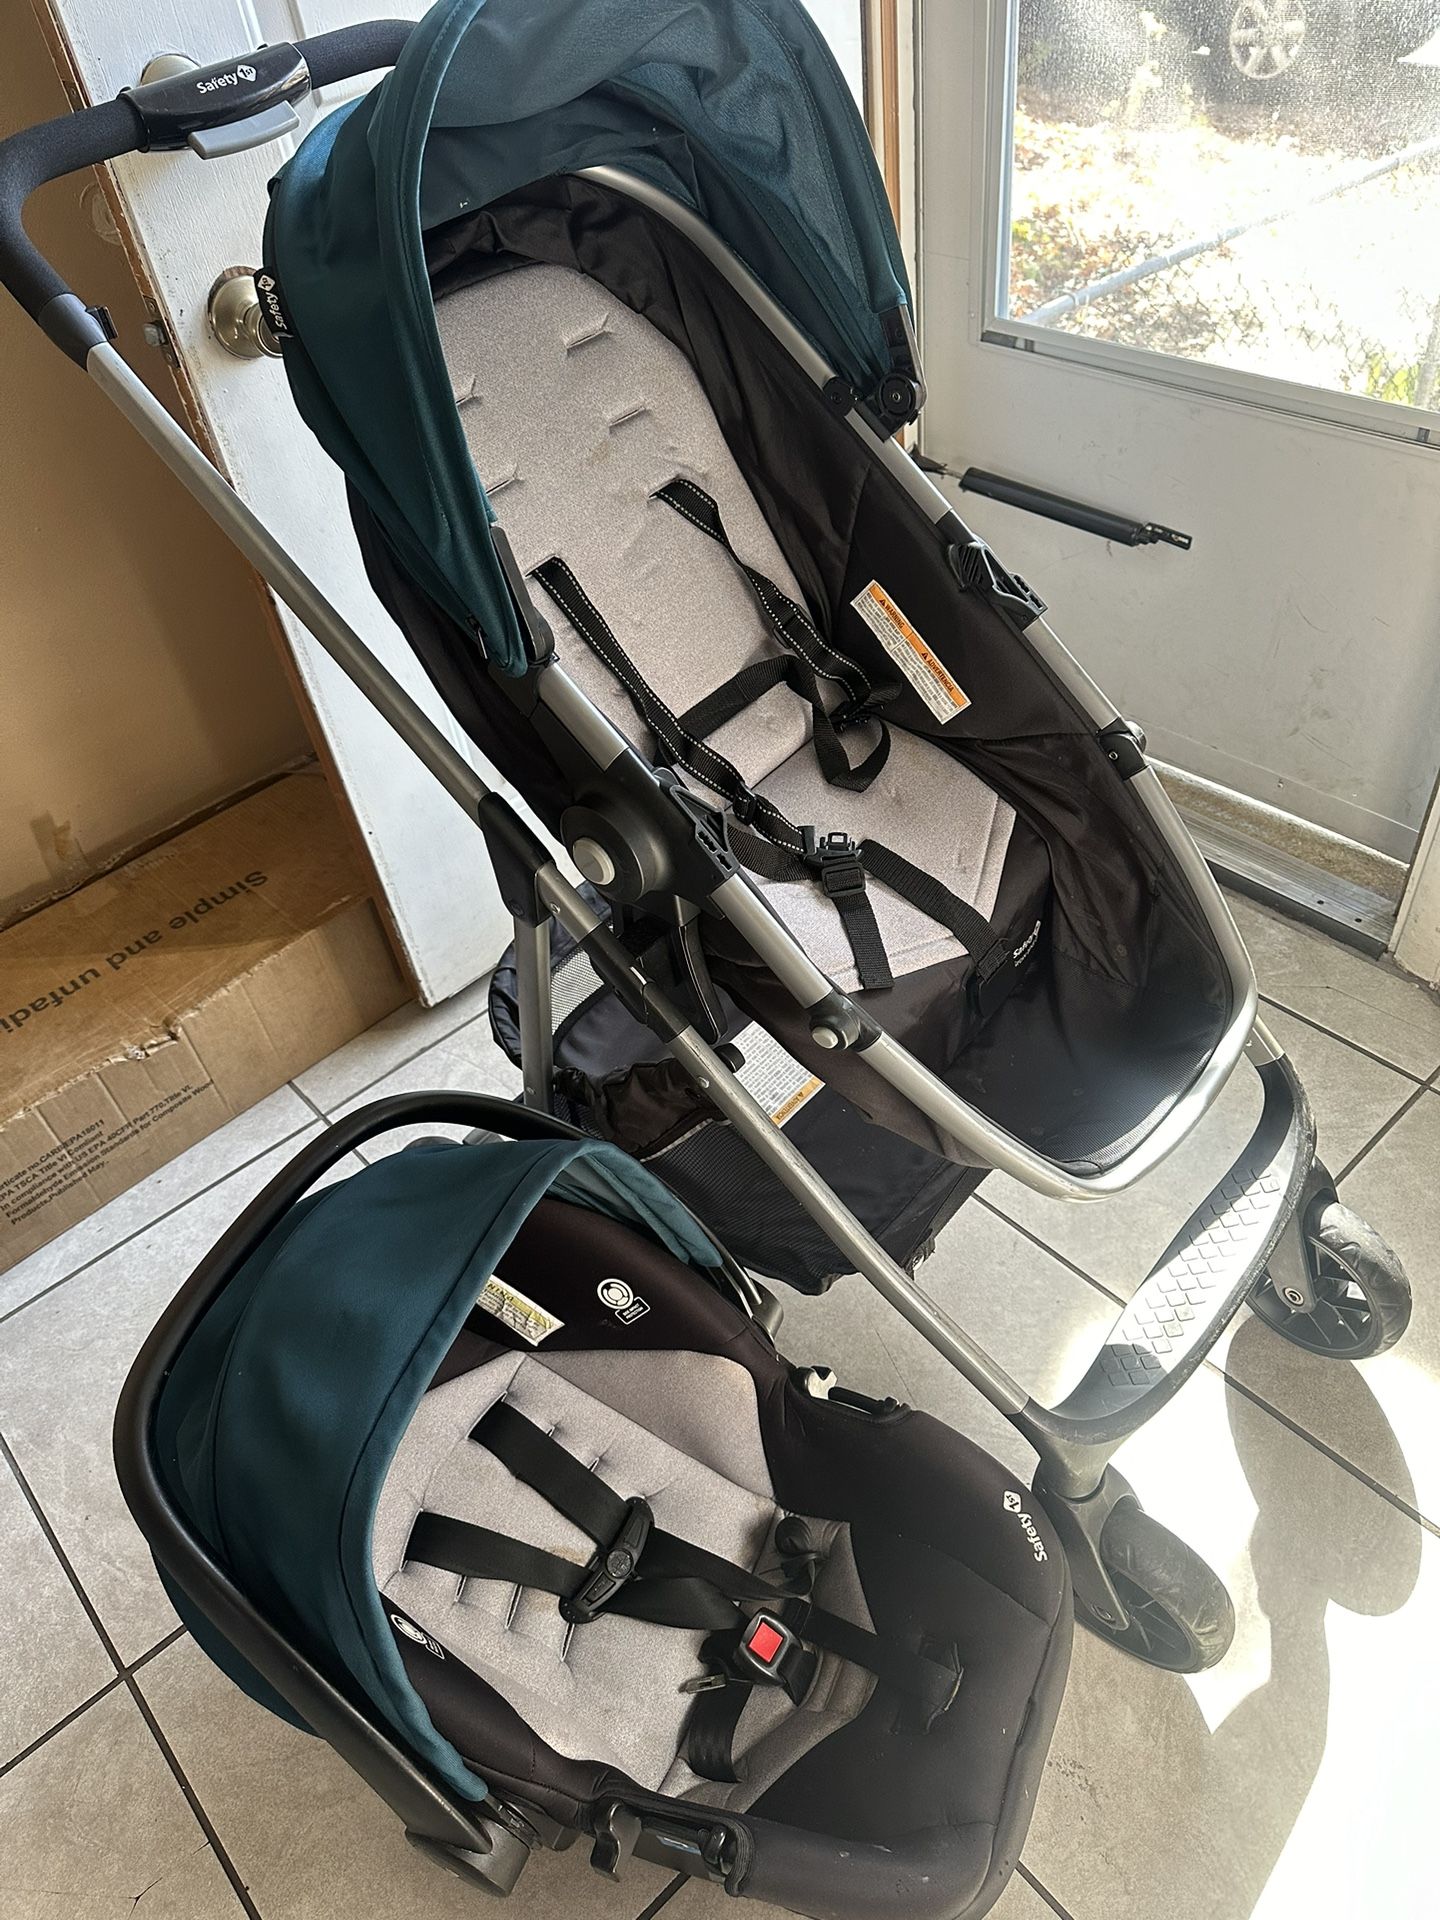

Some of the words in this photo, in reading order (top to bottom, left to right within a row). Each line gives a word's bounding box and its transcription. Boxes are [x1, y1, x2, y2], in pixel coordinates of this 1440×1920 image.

[196, 72, 238, 94] Safety
[265, 290, 288, 329] Safety
[885, 604, 905, 629] WARNING
[927, 658, 954, 692] ADVERTENCIA
[170, 871, 268, 931] Simple
[106, 930, 163, 971] and
[6, 1178, 63, 1217] Formaldehyde
[63, 1154, 99, 1179] Emission
[99, 1127, 139, 1155] Standards
[139, 1120, 151, 1129] for
[151, 1093, 192, 1122] Composite
[10, 1171, 57, 1205] compliance
[75, 1151, 87, 1161] US
[88, 1139, 105, 1153] EPA
[132, 1111, 149, 1124] Part
[15, 1172, 38, 1189] TSCA
[39, 1160, 57, 1174] Title
[1017, 1513, 1047, 1561] Safety
